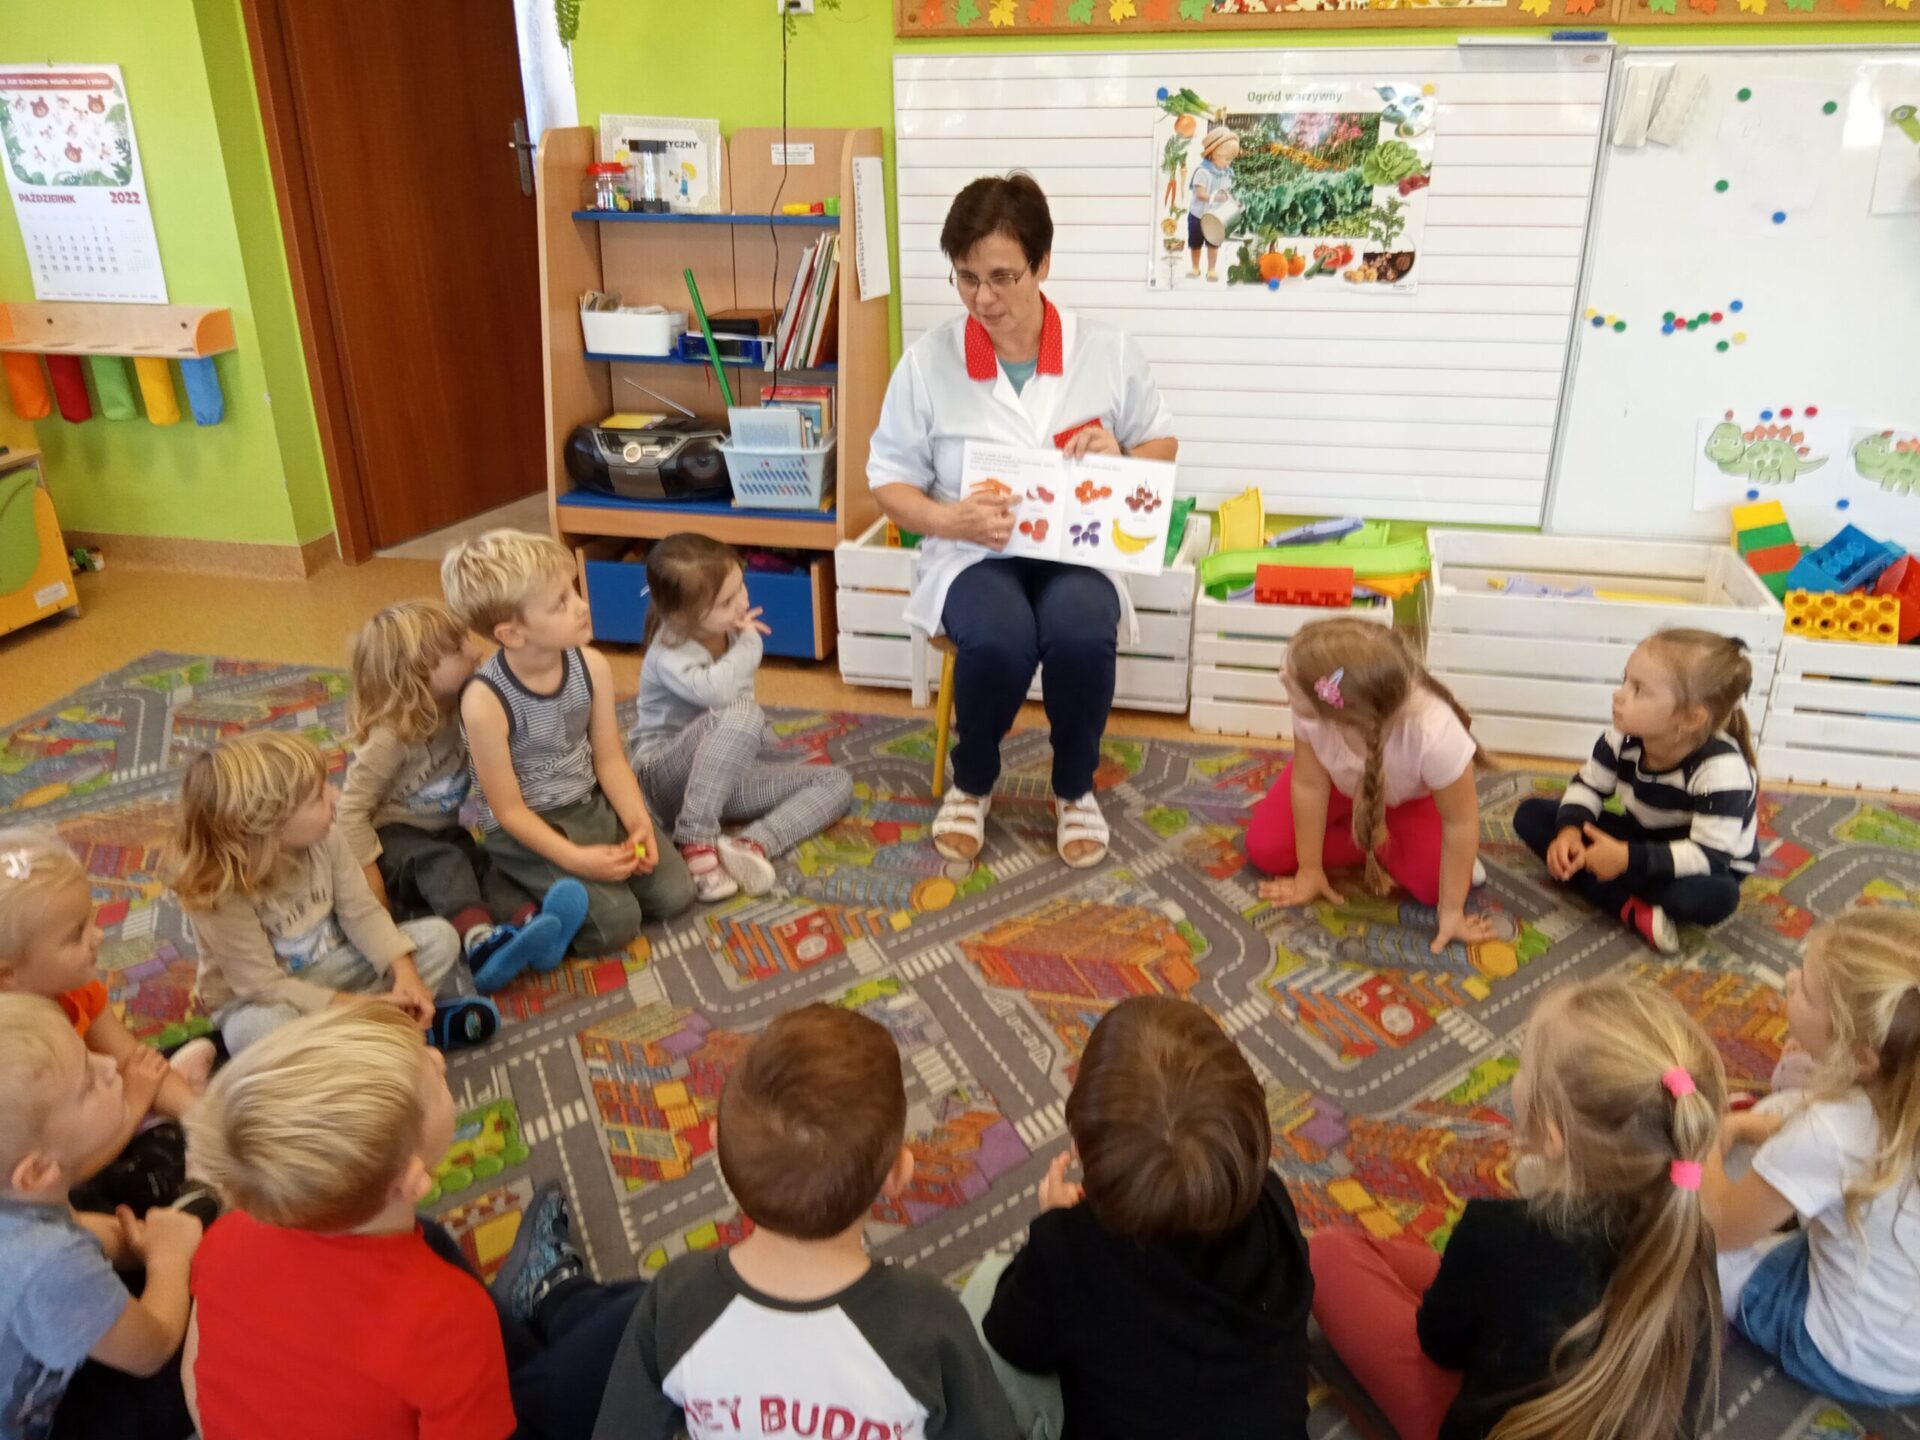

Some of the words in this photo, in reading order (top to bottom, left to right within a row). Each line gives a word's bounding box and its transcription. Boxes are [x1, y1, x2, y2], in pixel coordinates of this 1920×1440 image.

[1247, 91, 1282, 104] Ogród
[1285, 91, 1343, 104] warzywny
[109, 191, 141, 204] 2022
